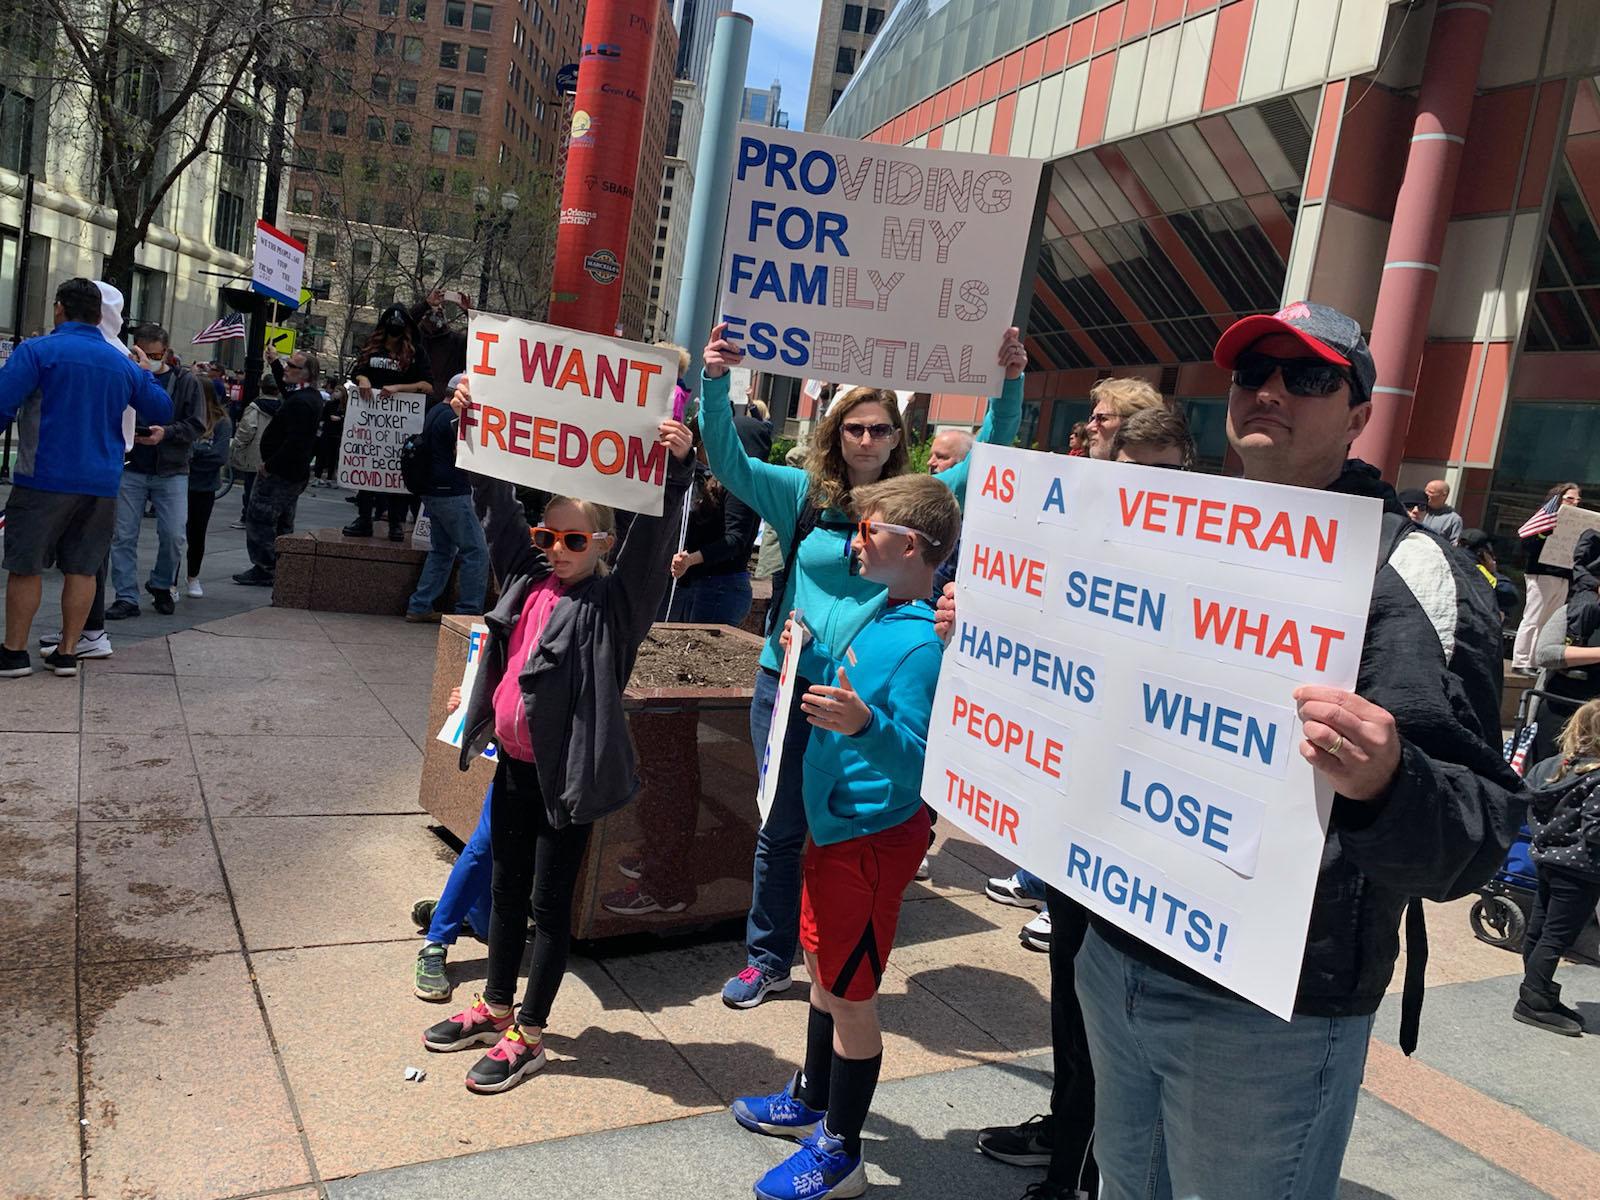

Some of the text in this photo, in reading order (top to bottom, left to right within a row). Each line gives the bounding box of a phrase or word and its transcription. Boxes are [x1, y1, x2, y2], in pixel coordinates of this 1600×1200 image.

[737, 136, 1012, 214] PROVIDING
[567, 208, 597, 219] Orleans
[748, 200, 966, 264] FOR MY
[729, 253, 989, 322] FAMILY IS
[473, 331, 662, 407] I WANT
[721, 314, 987, 384] ESSENTIAL
[351, 389, 360, 407] A
[341, 470, 349, 484] a
[350, 469, 382, 487] COVID
[343, 455, 367, 468] NOT
[459, 402, 667, 486] FREEDOM
[982, 465, 1338, 564] AS A VETERAN
[971, 543, 1345, 673] HAVE SEEN WHAT
[959, 621, 1278, 766] HAPPENS WHEN
[945, 769, 1021, 846] THEIR
[952, 695, 1233, 854] PEOPLE LOSE
[1067, 842, 1229, 964] RIGHTS!
